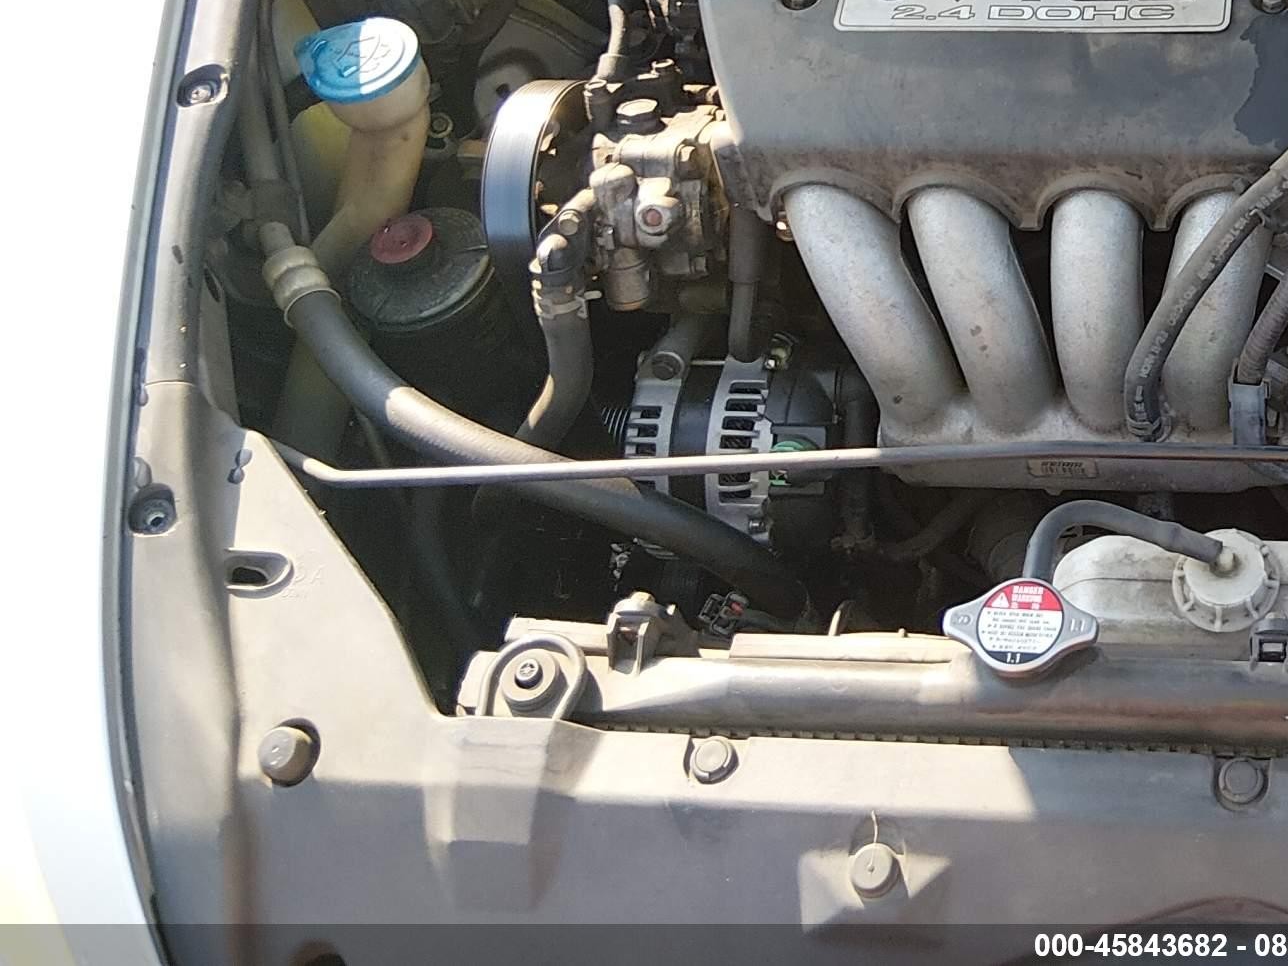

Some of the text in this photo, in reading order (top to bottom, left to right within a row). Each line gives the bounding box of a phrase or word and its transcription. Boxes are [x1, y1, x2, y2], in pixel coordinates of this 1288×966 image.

[891, 4, 1175, 21] 2.4 DOHC
[1006, 652, 1020, 663] 1.1
